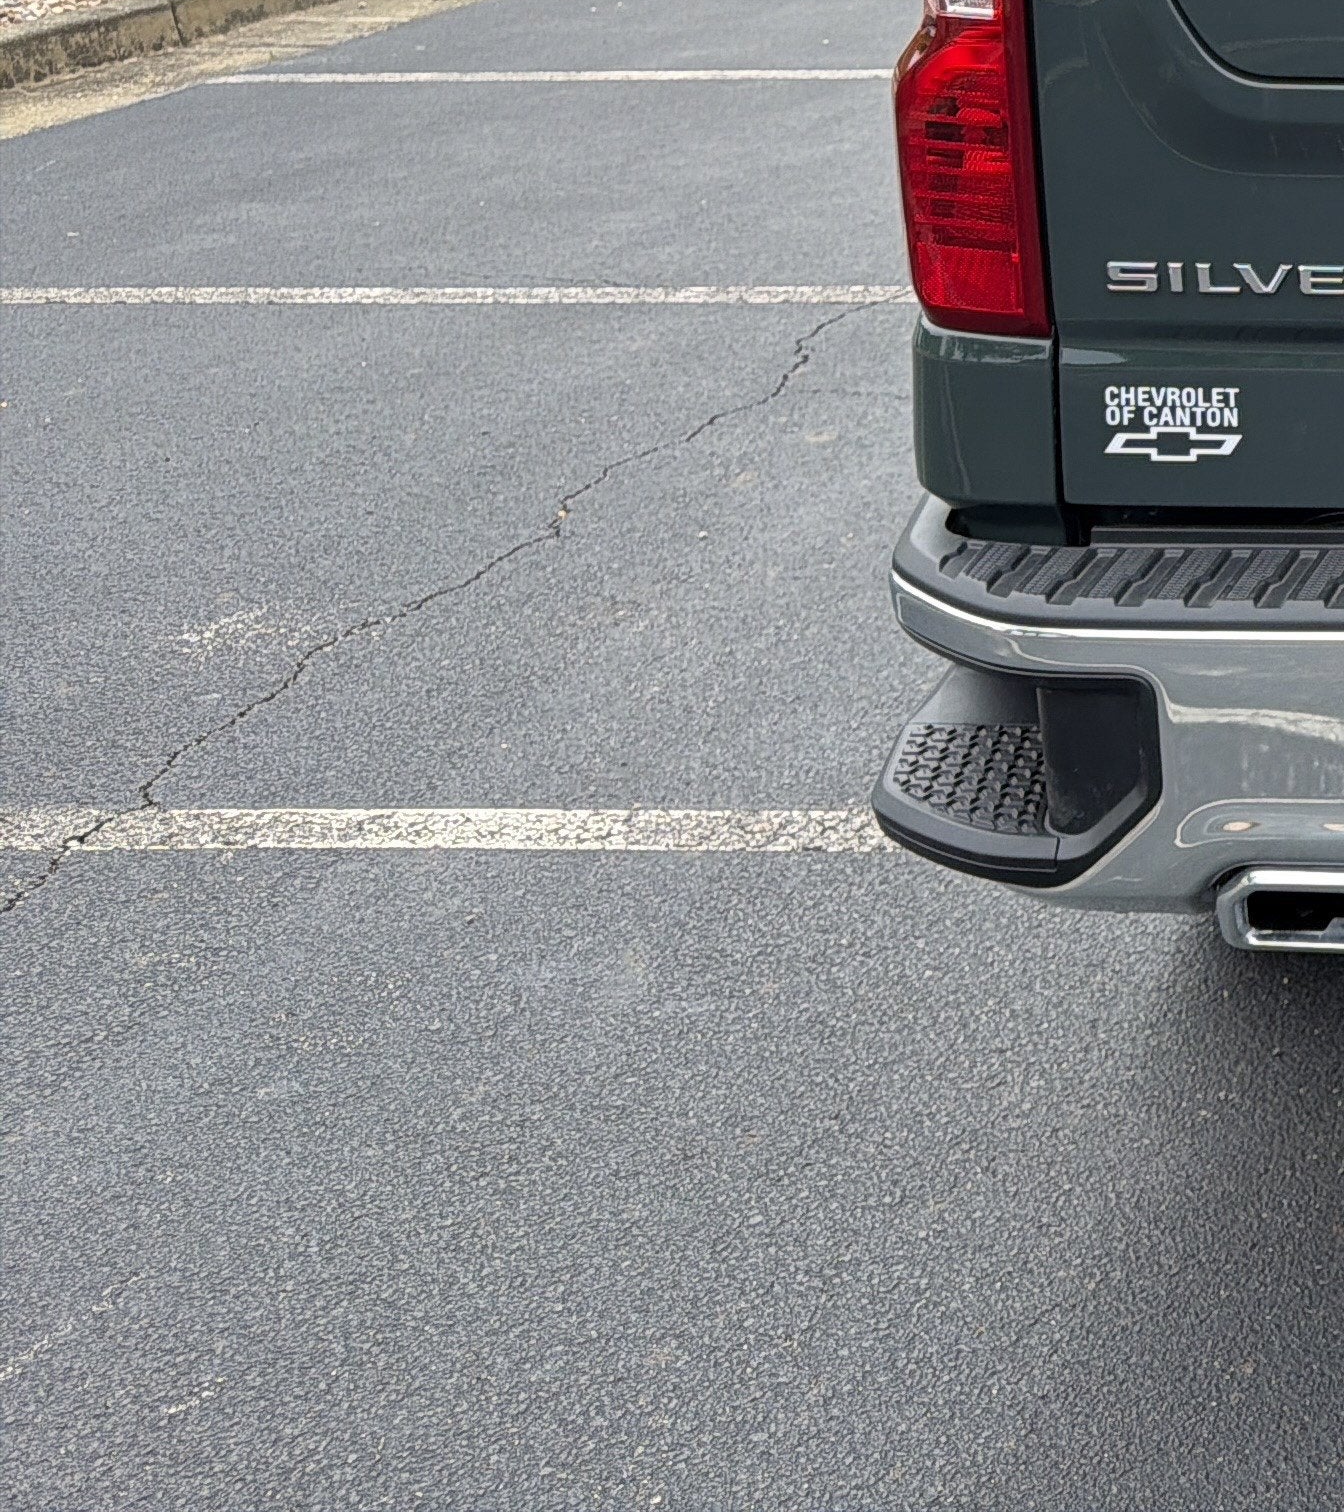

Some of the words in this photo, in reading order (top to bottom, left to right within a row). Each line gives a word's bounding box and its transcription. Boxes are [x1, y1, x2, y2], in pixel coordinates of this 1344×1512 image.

[1104, 387, 1239, 408] CHEVROLET
[1105, 407, 1136, 426] OF
[1143, 408, 1239, 428] CANTON
